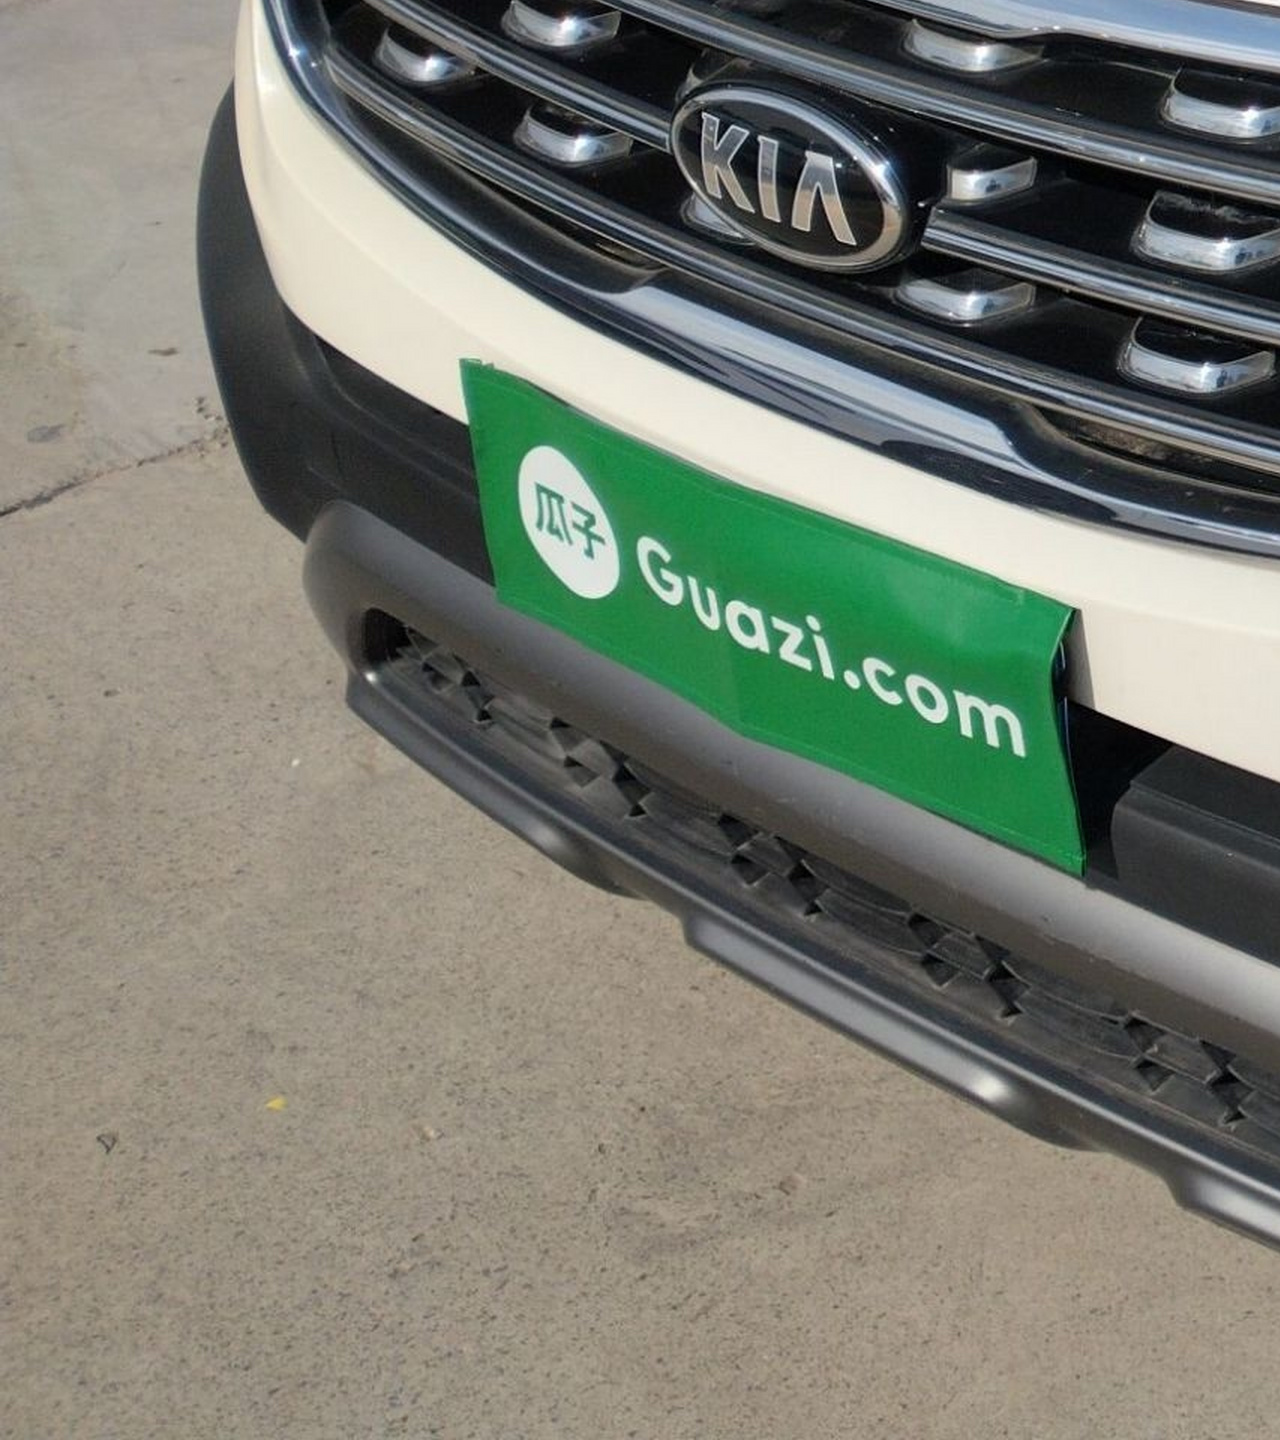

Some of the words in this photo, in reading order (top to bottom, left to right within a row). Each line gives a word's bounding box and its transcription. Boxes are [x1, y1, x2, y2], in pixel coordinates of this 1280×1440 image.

[702, 112, 857, 246] KIA
[534, 481, 606, 560] 瓜子
[636, 536, 1026, 758] Guazi.com
